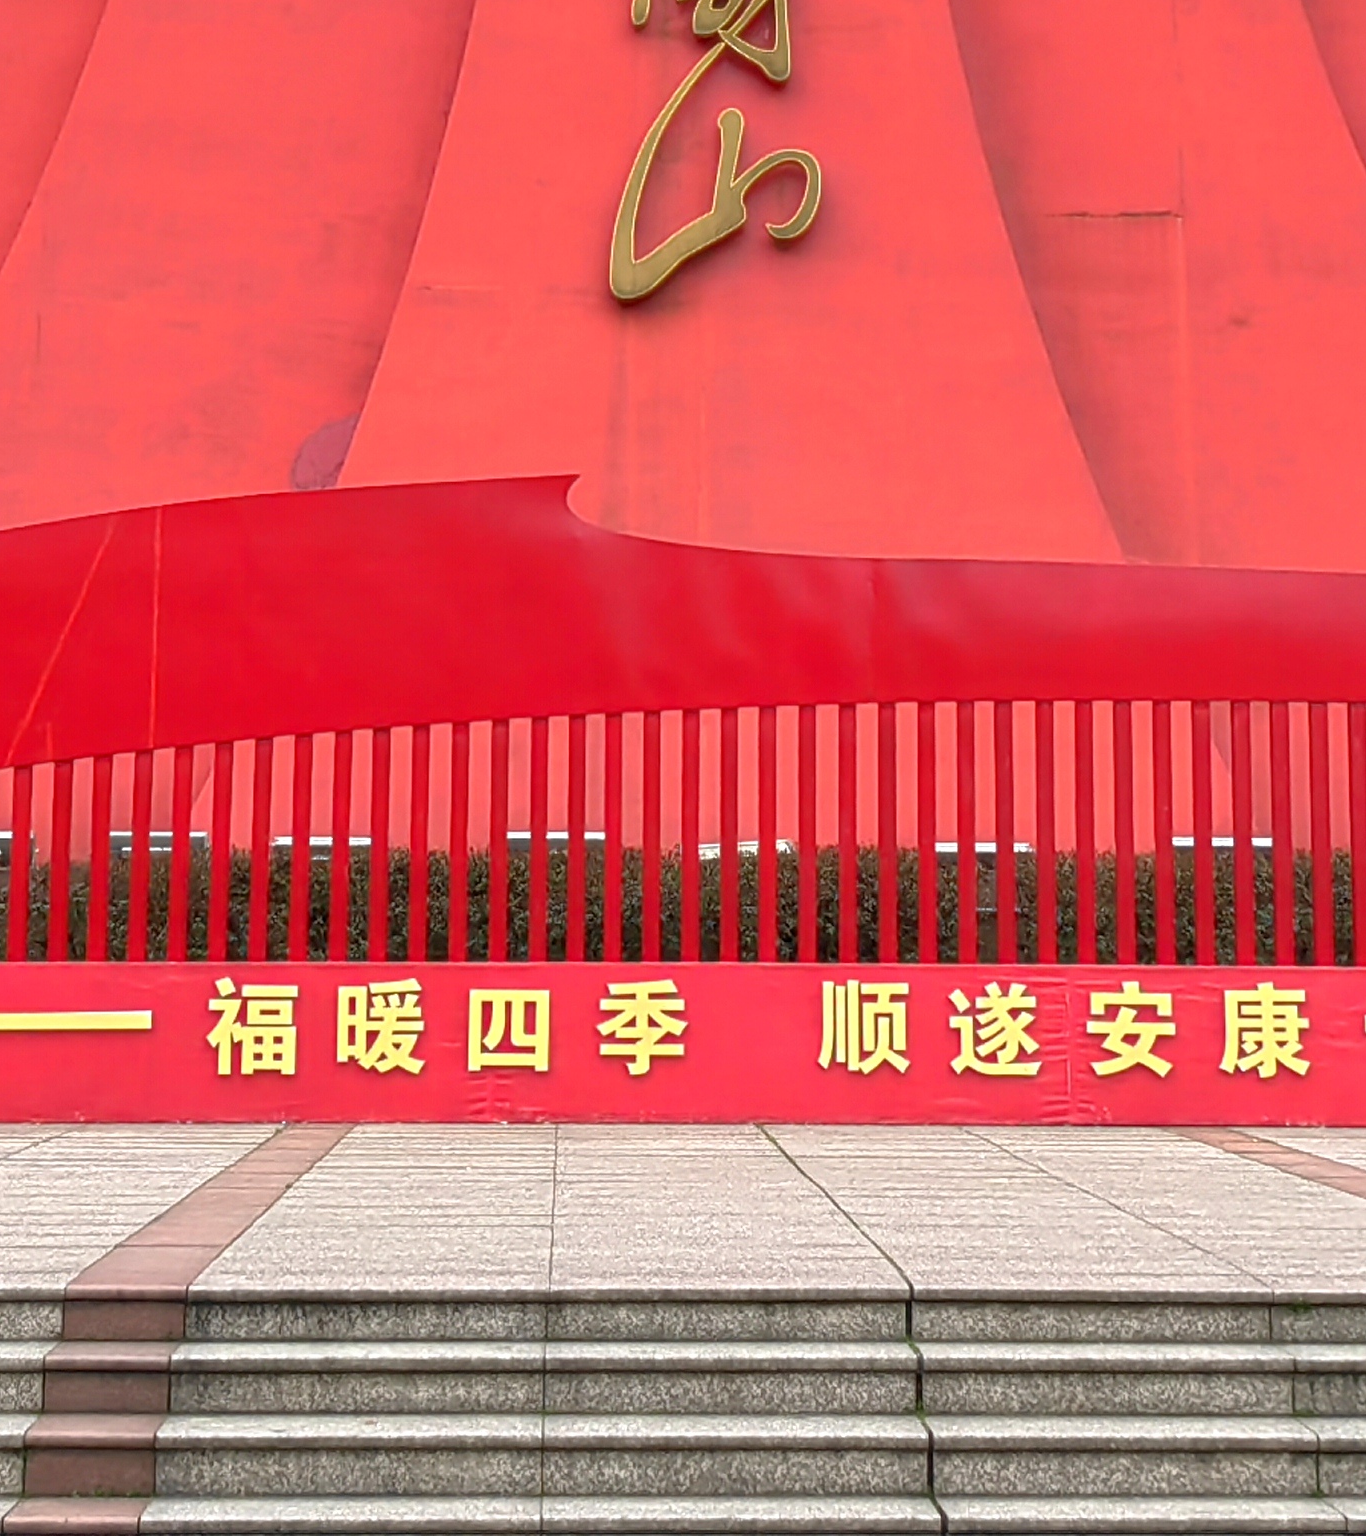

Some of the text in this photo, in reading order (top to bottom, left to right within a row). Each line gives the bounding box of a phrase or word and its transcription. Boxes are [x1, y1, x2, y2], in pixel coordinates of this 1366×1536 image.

[207, 976, 1312, 1079] 福暖四季 顺遂安康
